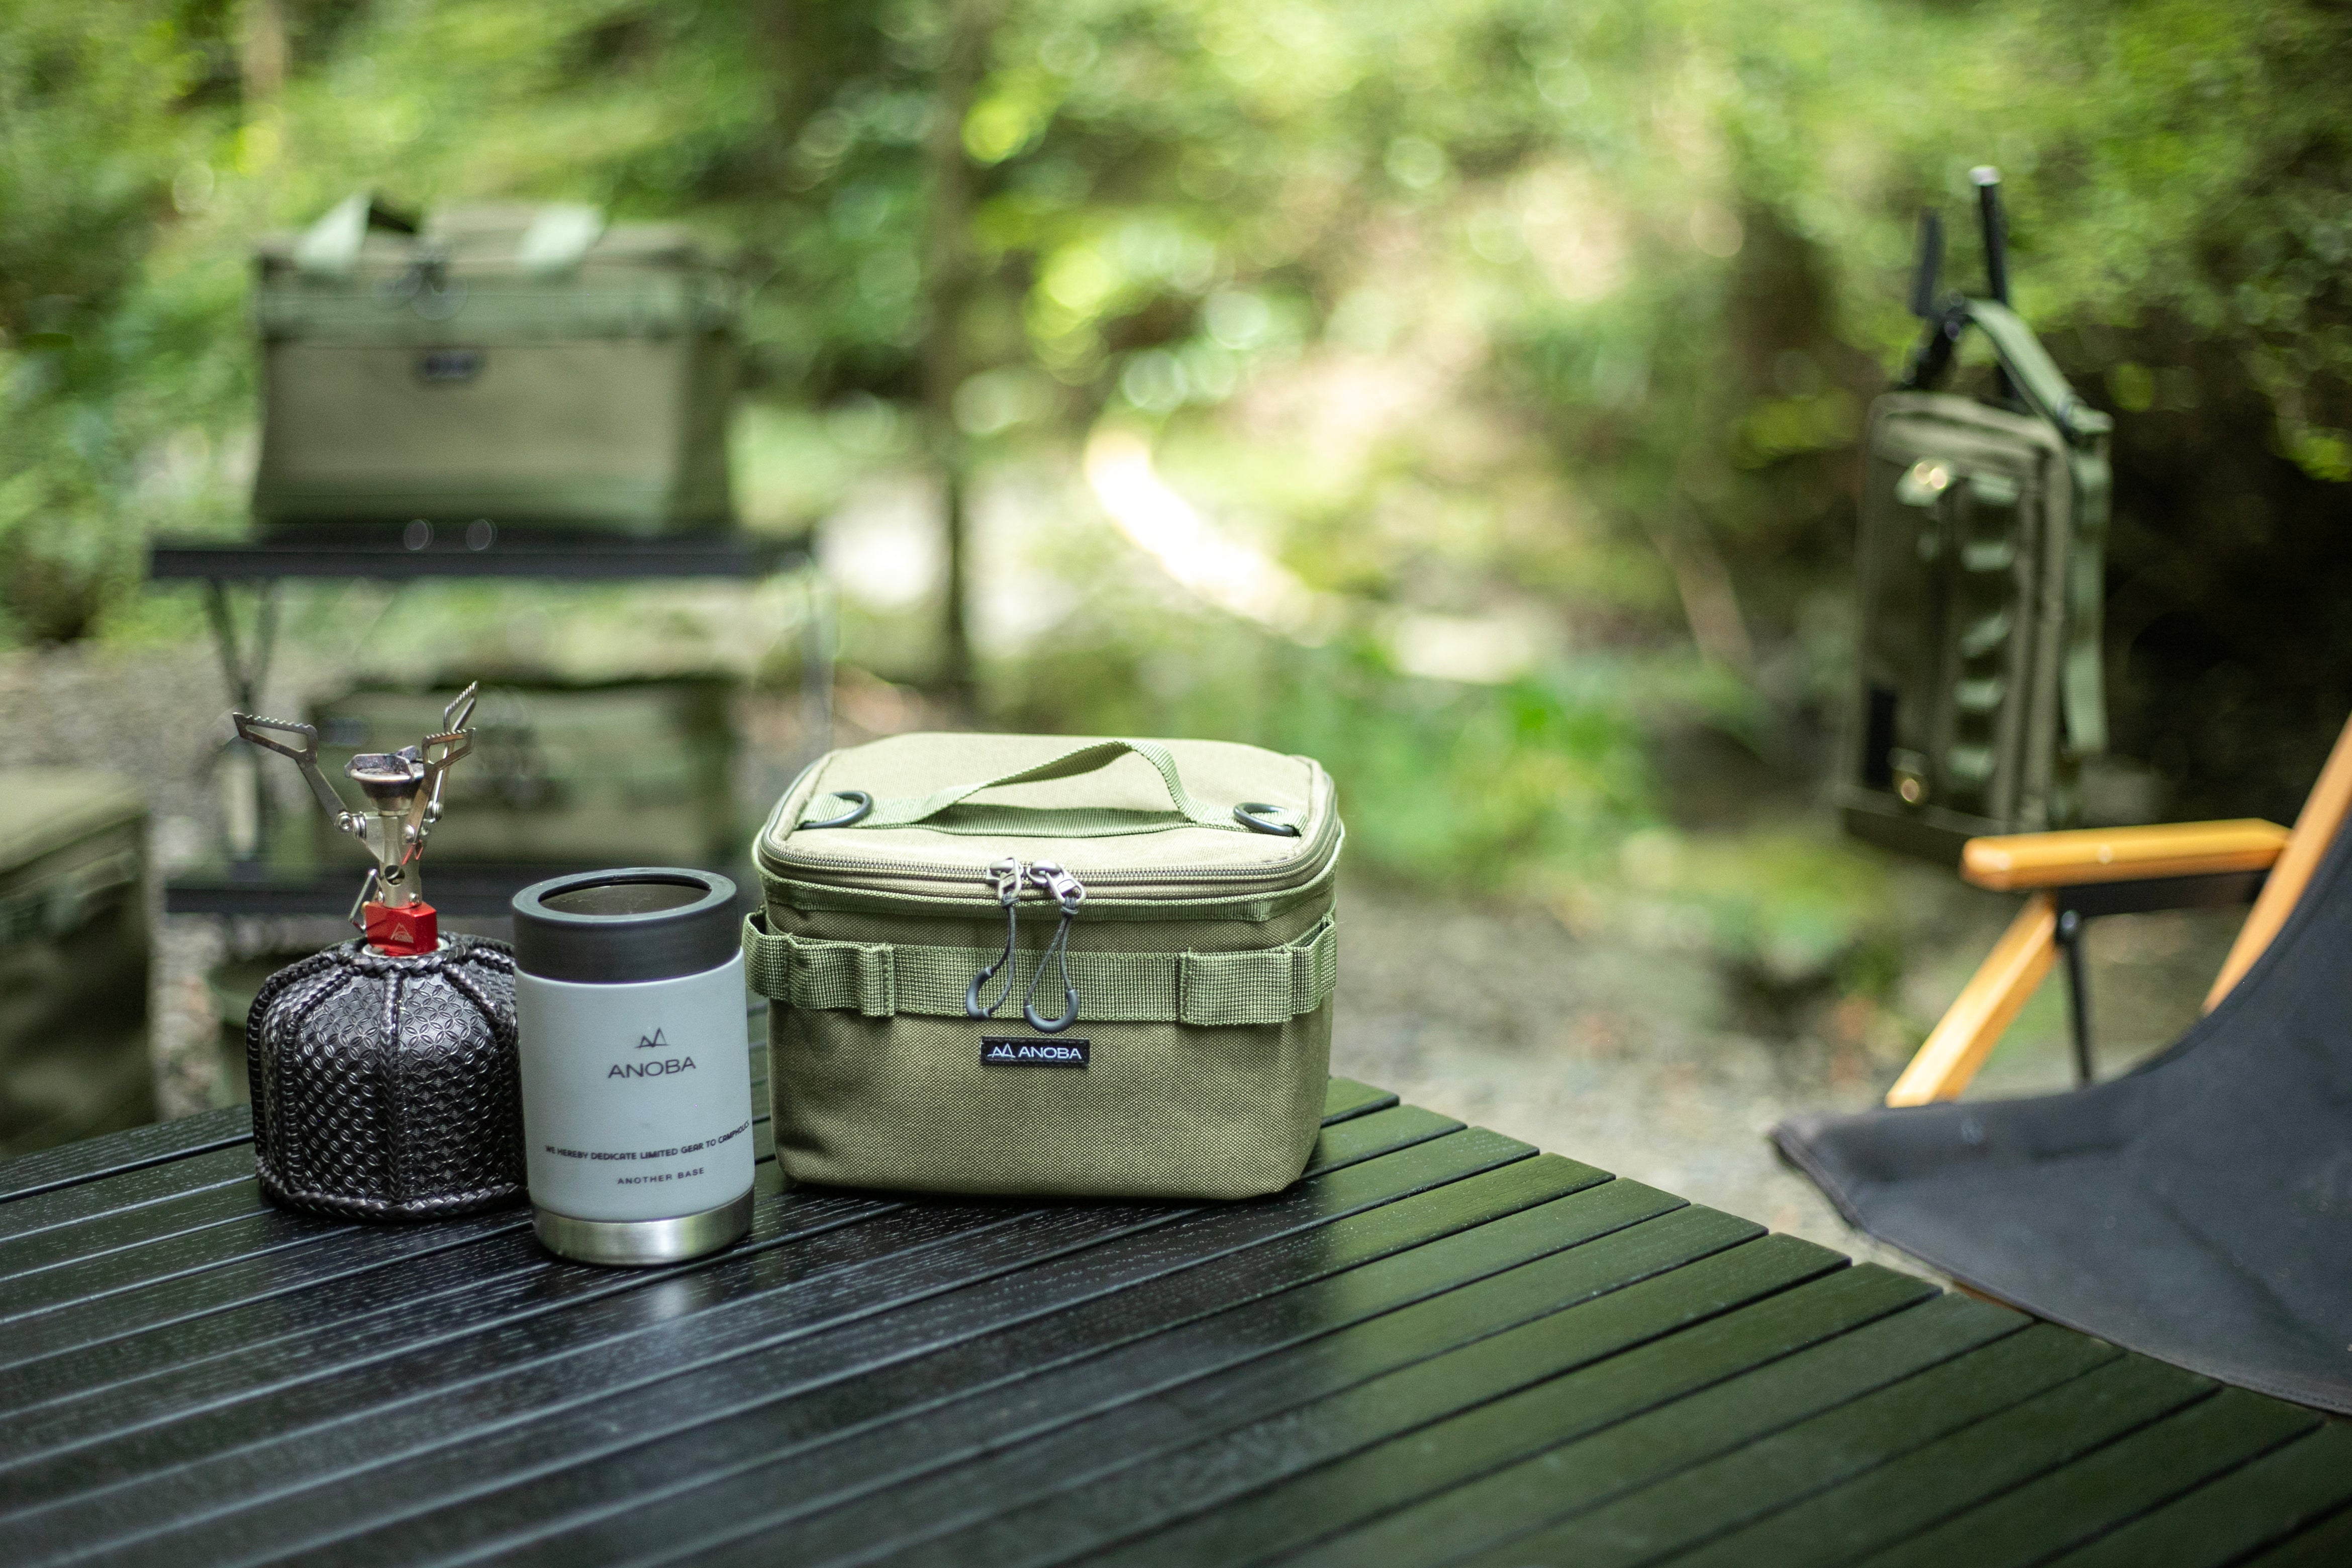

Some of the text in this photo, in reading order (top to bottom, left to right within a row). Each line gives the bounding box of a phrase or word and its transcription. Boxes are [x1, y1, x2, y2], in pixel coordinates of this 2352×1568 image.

[1018, 1046, 1082, 1059] ANOBA
[608, 1056, 697, 1079] ANOBA
[545, 1145, 555, 1154] WE
[557, 1148, 589, 1159] HEREBY
[591, 1152, 637, 1160] DEDICATE
[640, 1148, 678, 1159] LIMITED
[680, 1142, 704, 1154] GEAR
[706, 1139, 716, 1148] TO
[617, 1167, 705, 1185] ANOTHER BASE
